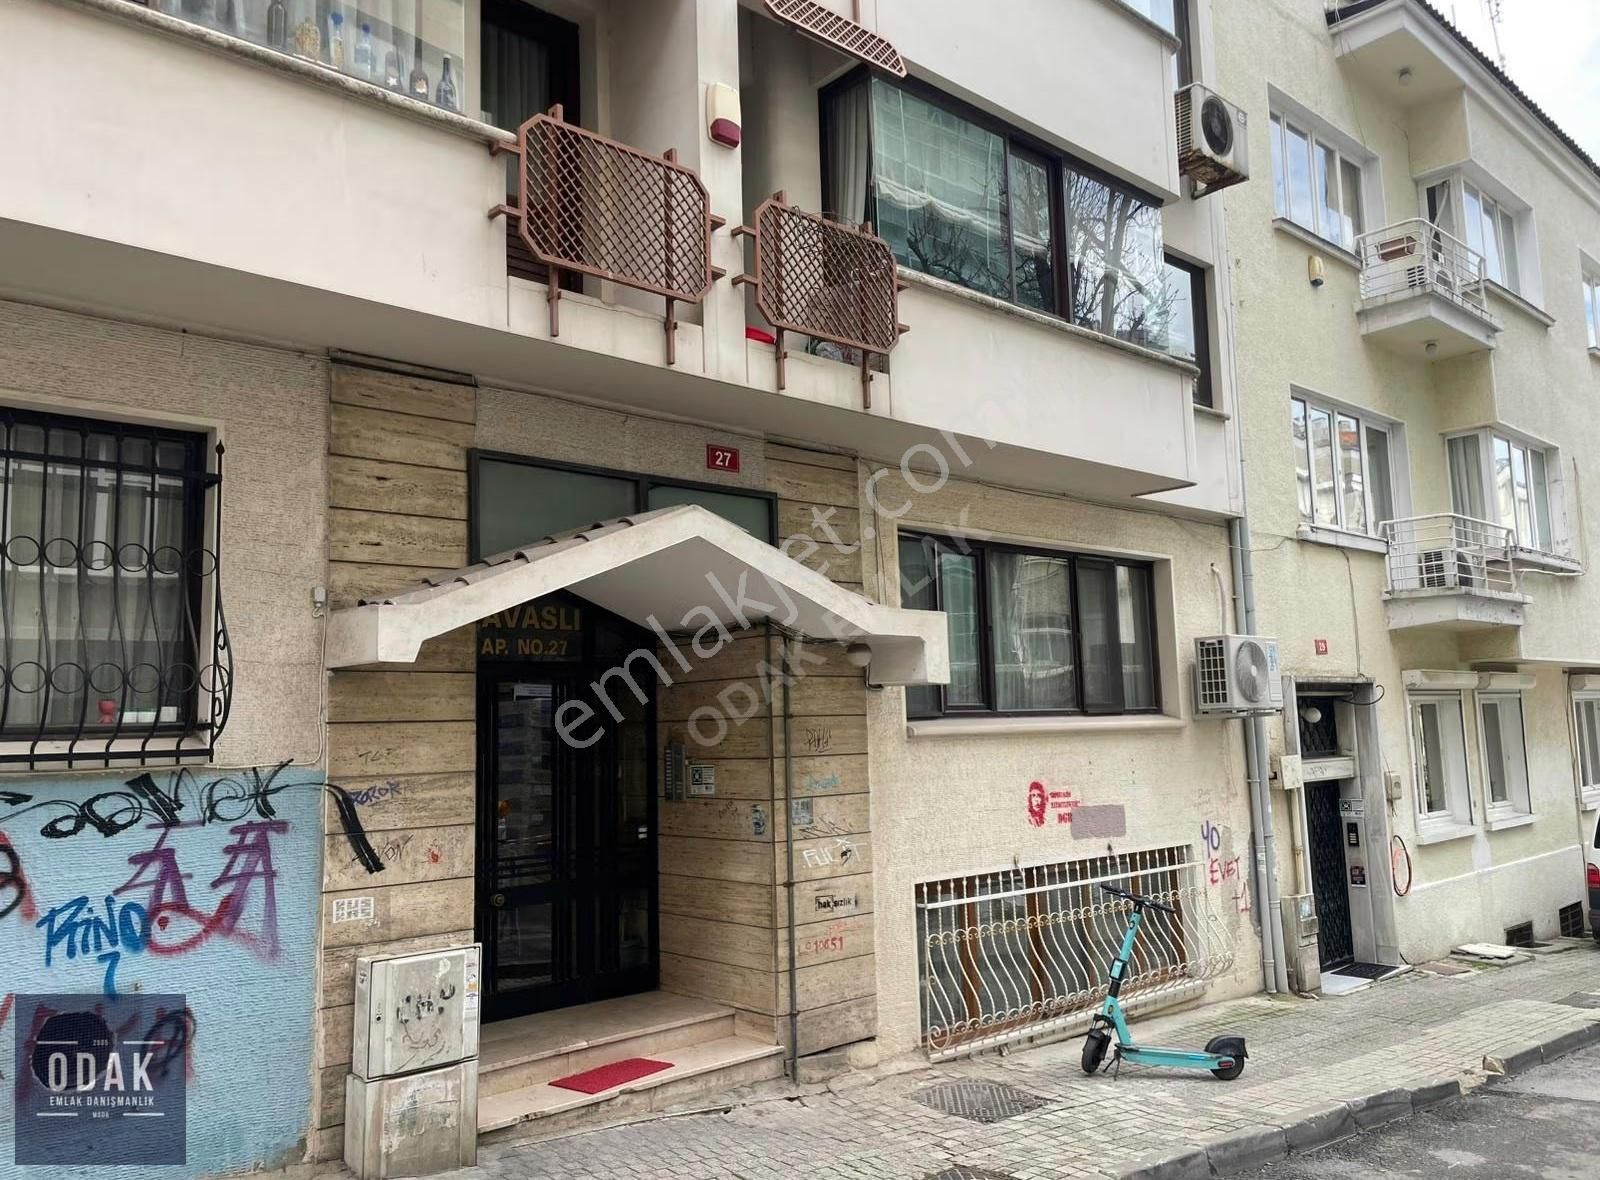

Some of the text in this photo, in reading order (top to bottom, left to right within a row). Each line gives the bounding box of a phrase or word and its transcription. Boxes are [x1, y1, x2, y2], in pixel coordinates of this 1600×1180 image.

[715, 450, 732, 467] 27
[481, 638, 568, 656] AP. NO.27
[1201, 820, 1220, 859] 40
[1209, 855, 1240, 887] EVET
[1231, 881, 1250, 914] +1
